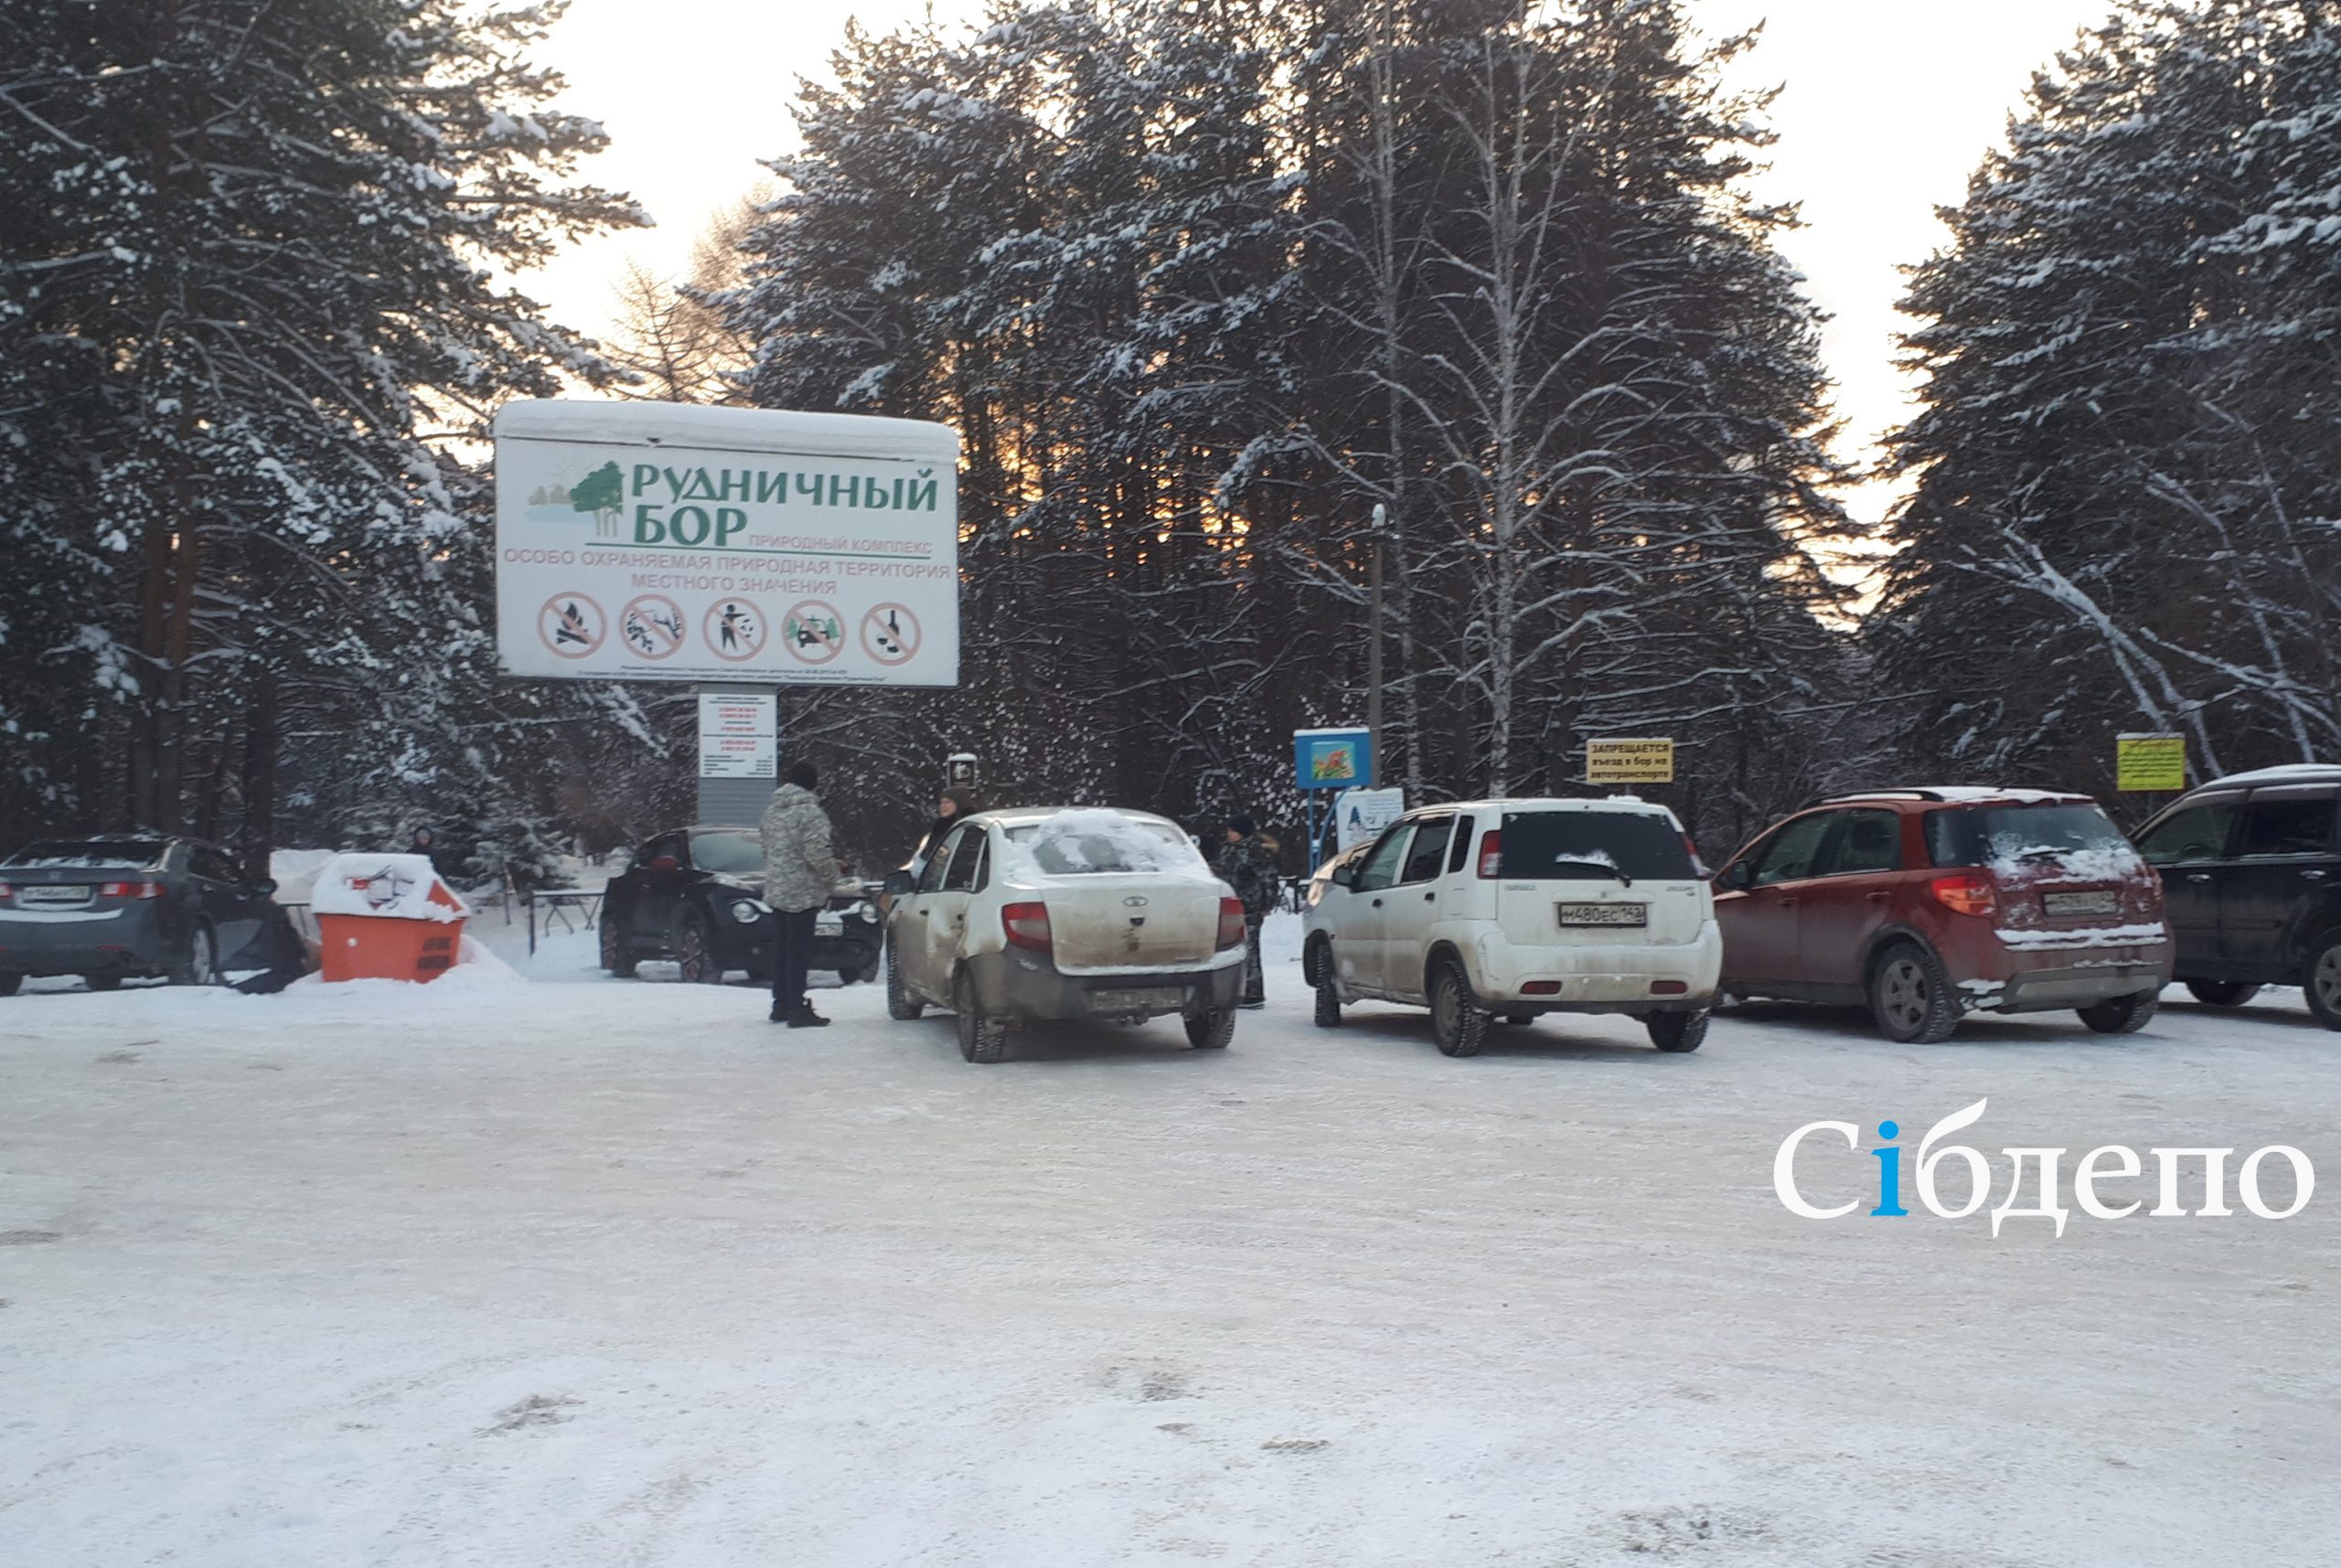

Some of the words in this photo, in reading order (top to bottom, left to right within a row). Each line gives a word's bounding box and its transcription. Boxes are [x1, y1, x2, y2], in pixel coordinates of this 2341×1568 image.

[632, 464, 938, 511] РУДНИЧНЫЙ
[634, 505, 748, 547] БОР
[749, 535, 849, 551] ПРИРОДНЫЙ
[851, 539, 934, 555] КОМПЛЕКС
[504, 549, 574, 565] ОСОБО
[581, 550, 712, 571] ОХРАНЯЕМАЯ
[717, 557, 830, 576] ПРИРОДНАЯ
[835, 561, 950, 579] ТЕРРИТОРИЯ
[631, 574, 734, 592] МЕСТНОГО
[739, 578, 838, 594] ЗНАЧЕНИЯ
